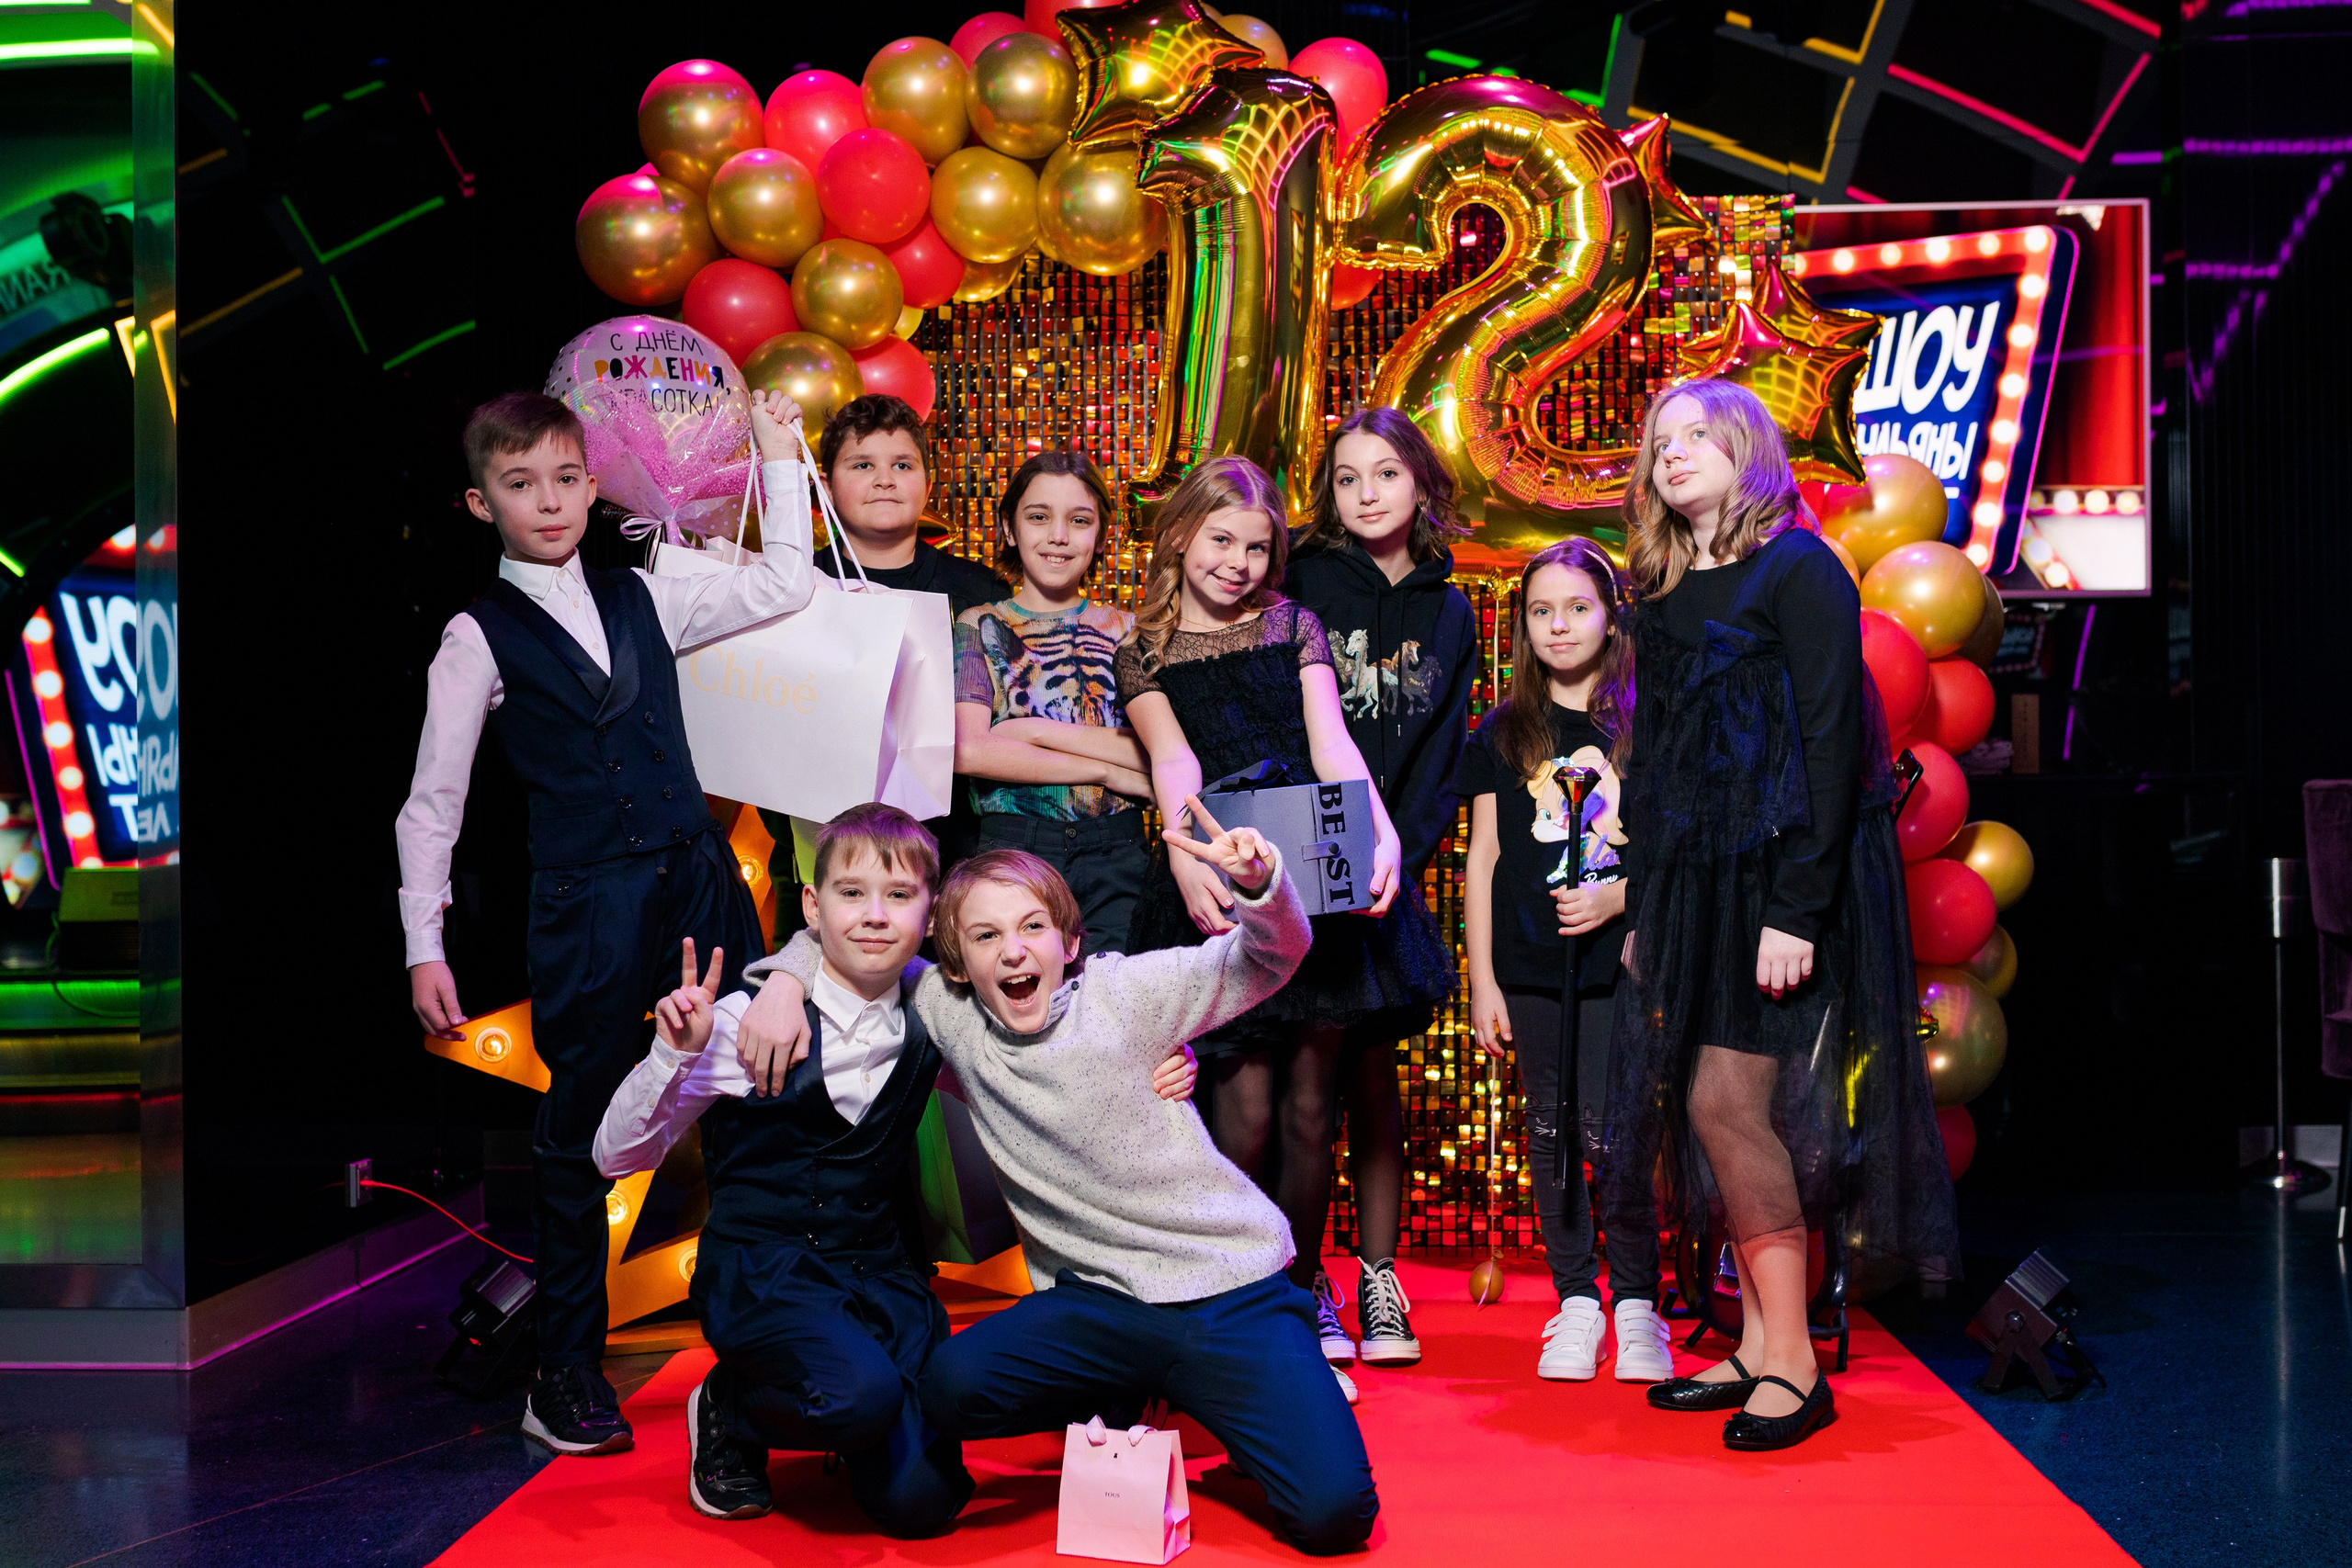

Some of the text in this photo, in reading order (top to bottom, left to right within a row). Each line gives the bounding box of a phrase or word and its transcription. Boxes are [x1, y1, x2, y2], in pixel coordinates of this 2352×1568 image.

[610, 329, 705, 356] С ДНЁМ
[1852, 299, 2001, 415] ШОУ
[688, 644, 818, 715] Chloé
[1546, 834, 1620, 883] Lla
